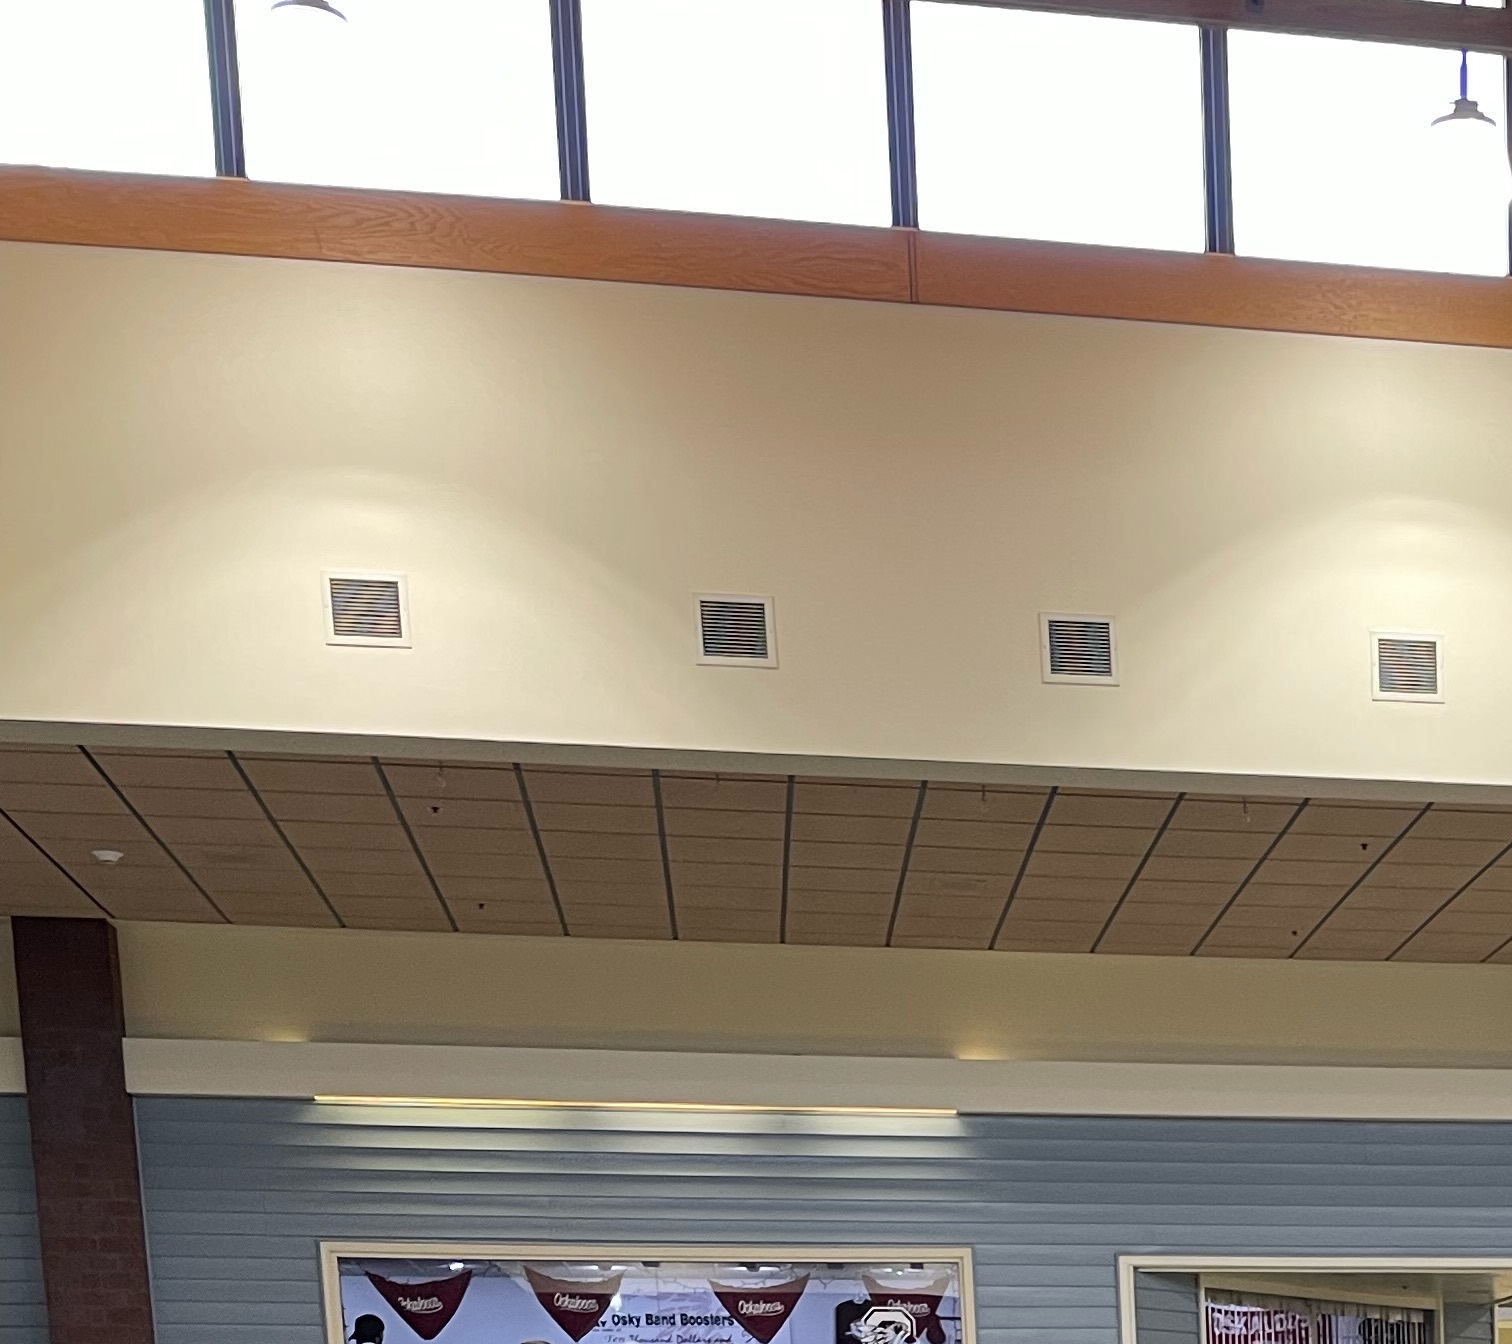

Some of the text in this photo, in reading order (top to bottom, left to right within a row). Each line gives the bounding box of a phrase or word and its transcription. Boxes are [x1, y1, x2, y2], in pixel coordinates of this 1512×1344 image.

[612, 1313, 641, 1328] Osky
[645, 1313, 676, 1326] Band
[680, 1313, 735, 1327] Boosters
[676, 1334, 712, 1344] Dollars
